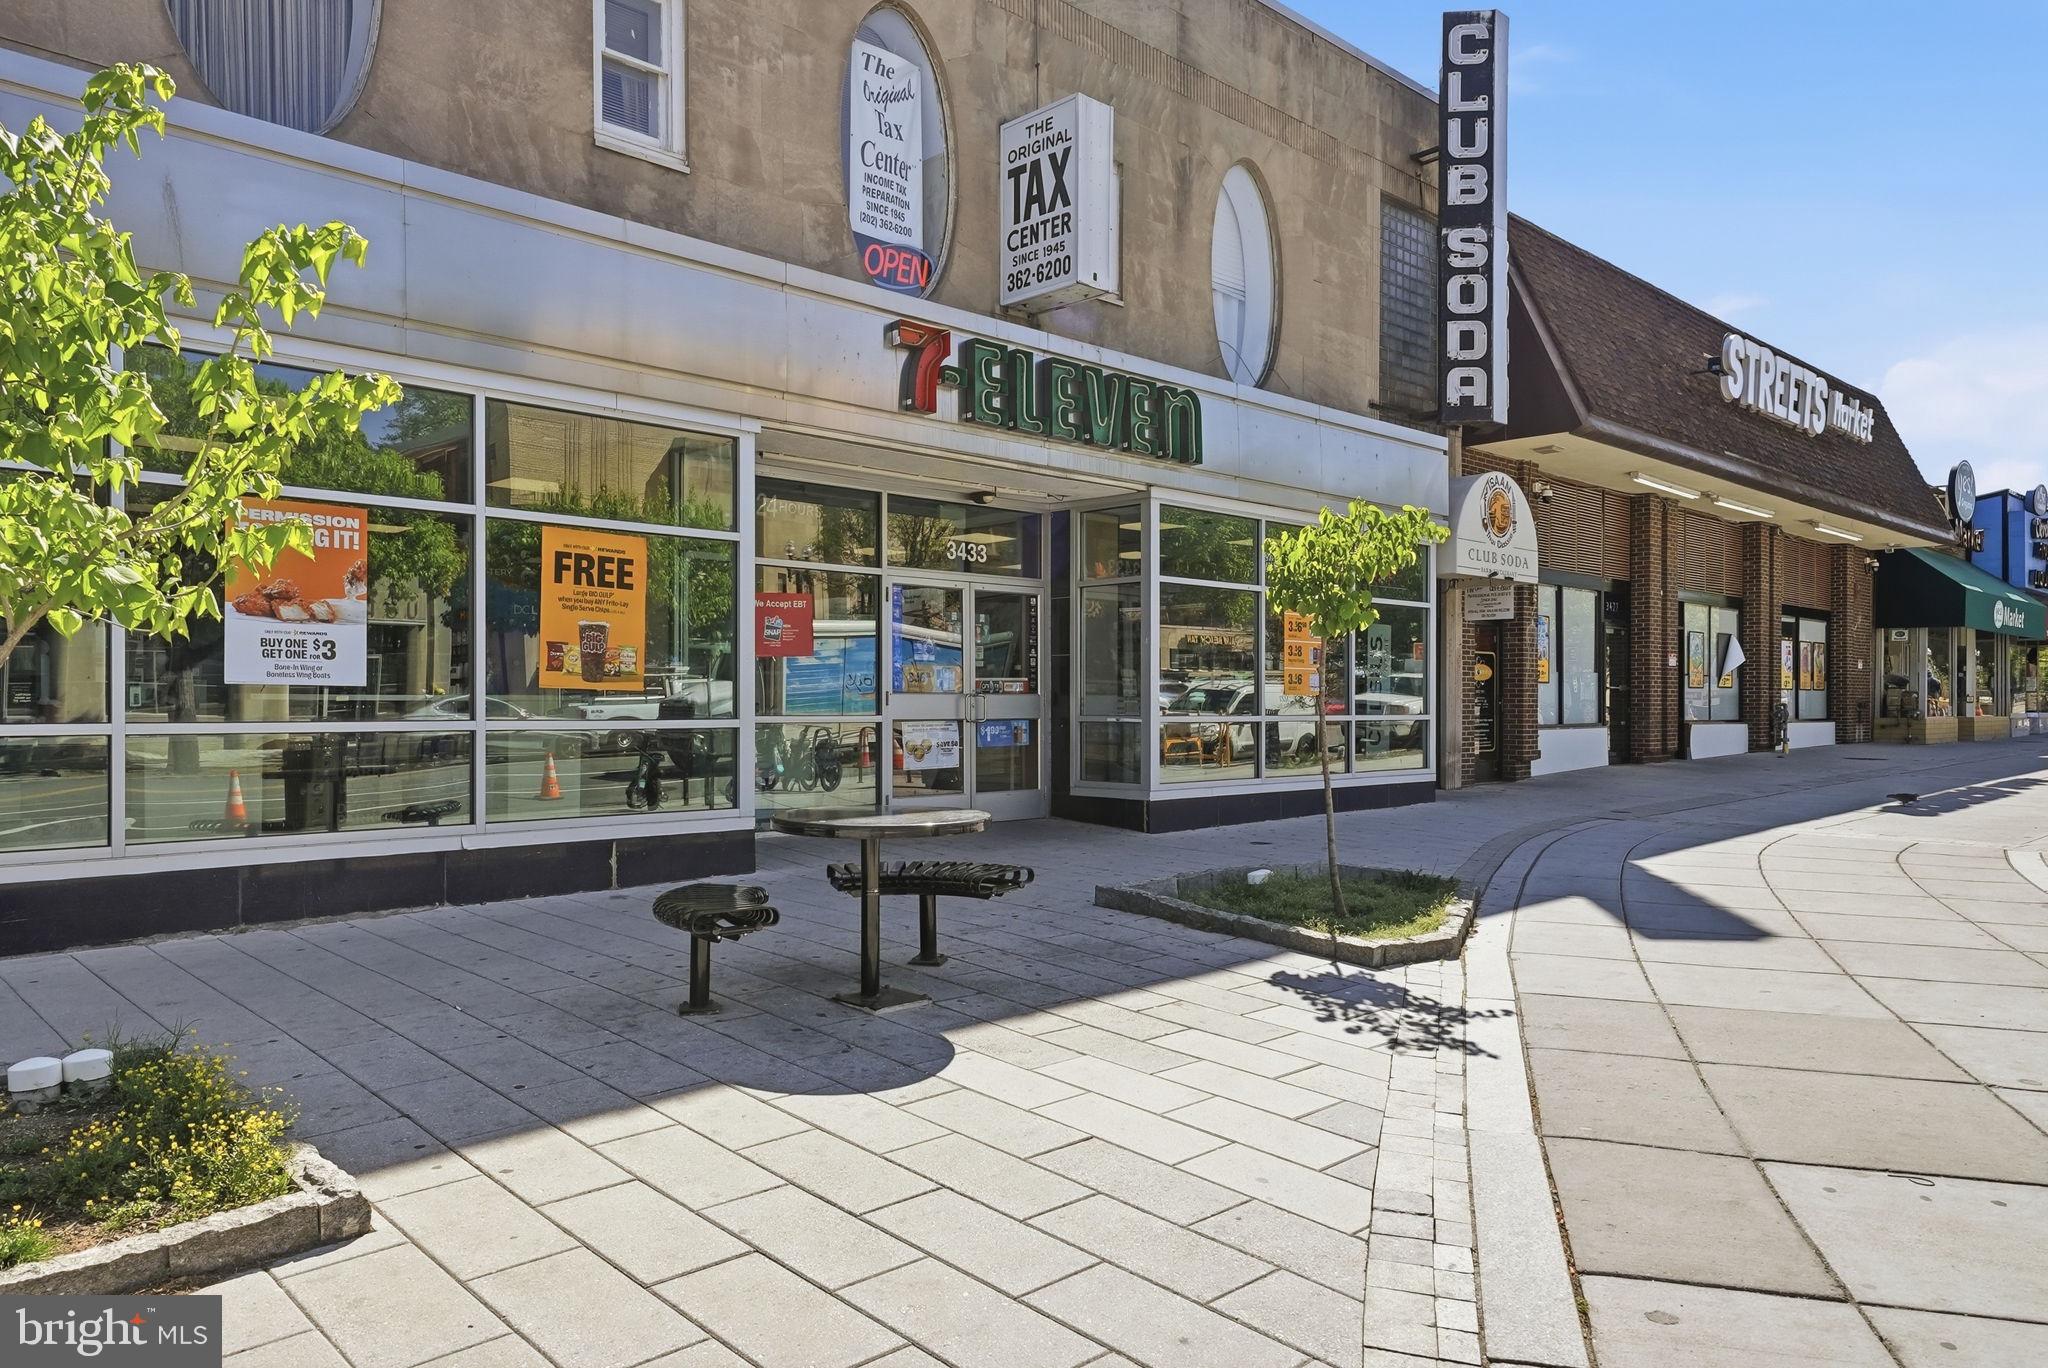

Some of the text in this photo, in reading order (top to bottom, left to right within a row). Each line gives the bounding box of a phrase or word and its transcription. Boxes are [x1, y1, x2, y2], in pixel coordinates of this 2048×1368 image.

[861, 51, 895, 79] The
[863, 78, 915, 113] Original
[874, 108, 904, 141] Tax
[1447, 23, 1489, 206] CLUB
[1025, 116, 1054, 139] THE
[1007, 128, 1073, 164] ORIGINAL
[860, 140, 912, 182] Center
[864, 172, 907, 197] INCOME TAX
[1007, 145, 1072, 226] TAX
[862, 185, 910, 211] PREPARATION
[866, 200, 906, 222] SINCE 1945
[859, 211, 913, 238] (202) 362-6200
[1006, 211, 1072, 252] CENTER
[864, 243, 929, 287] OPEN
[1012, 240, 1066, 267] SINCE 1945
[1446, 227, 1489, 408] SODA
[1721, 333, 1875, 443] STREETS Market
[333, 530, 360, 550] IT!
[946, 540, 988, 563] 3433
[554, 550, 634, 591] FREE
[1468, 548, 1529, 569] CLUB SODA
[584, 598, 594, 606] buy
[766, 600, 792, 609] Accept
[793, 600, 807, 608] EBT
[2003, 606, 2025, 628] Market
[260, 637, 308, 649] BUY ONE
[313, 638, 337, 660] $3
[582, 641, 606, 653] GULP
[586, 632, 603, 643] BIG
[261, 648, 283, 659] GET
[285, 649, 308, 660] ONE
[266, 670, 295, 678] Boneless
[296, 671, 312, 679] Wing
[274, 663, 299, 671] Bone-In
[300, 664, 316, 672] Wing
